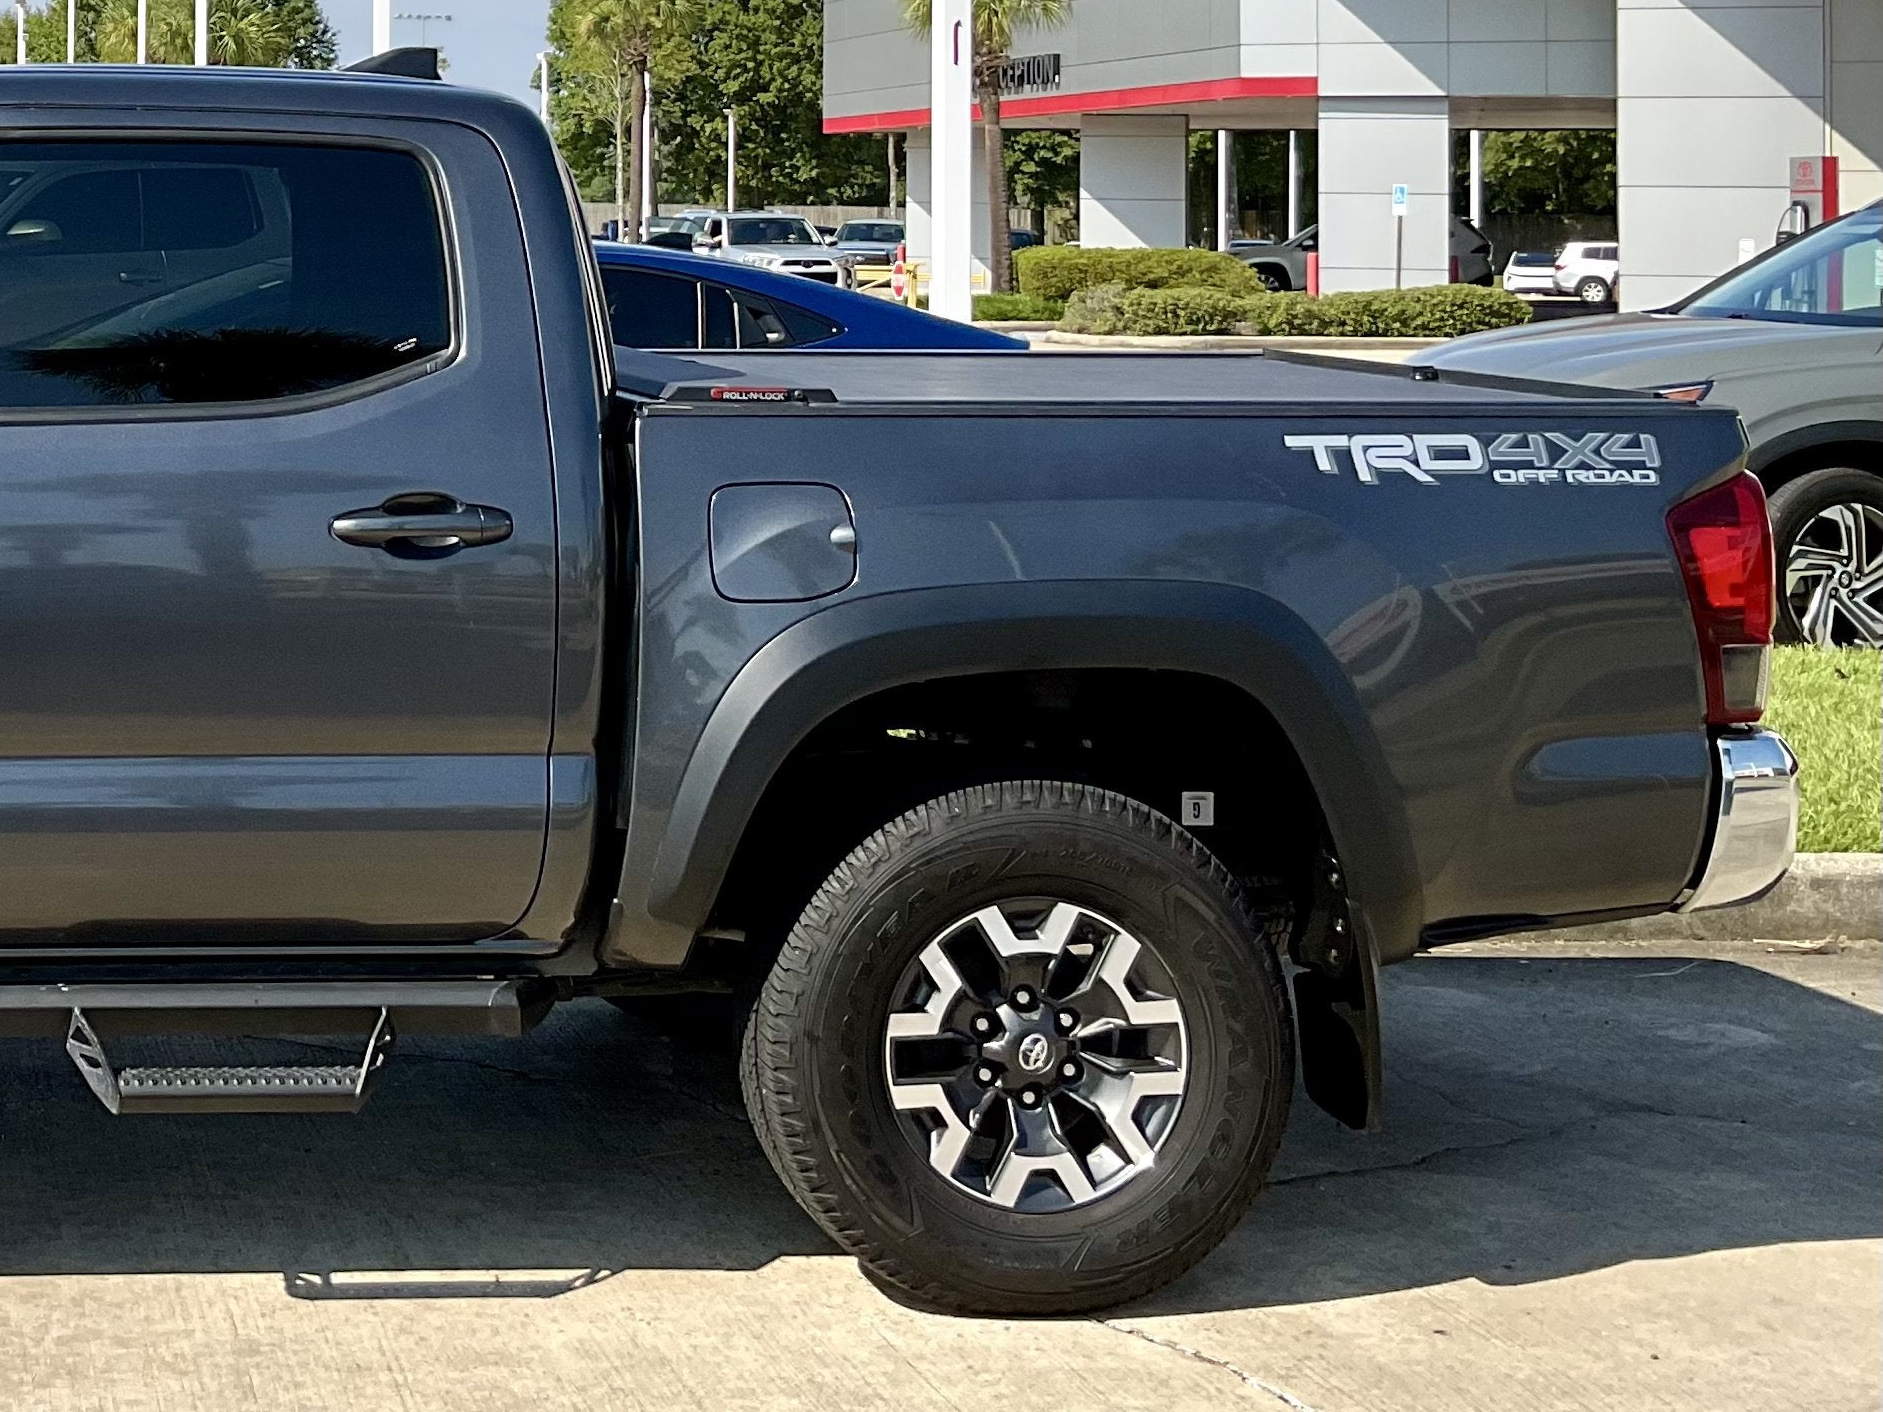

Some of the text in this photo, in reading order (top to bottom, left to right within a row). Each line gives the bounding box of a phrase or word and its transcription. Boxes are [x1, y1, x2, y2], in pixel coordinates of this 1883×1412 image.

[998, 54, 1060, 89] CEPTION
[1283, 433, 1488, 485] TRD
[1492, 468, 1660, 486] OFF ROAD
[1117, 938, 1250, 1256] WRANGLER
